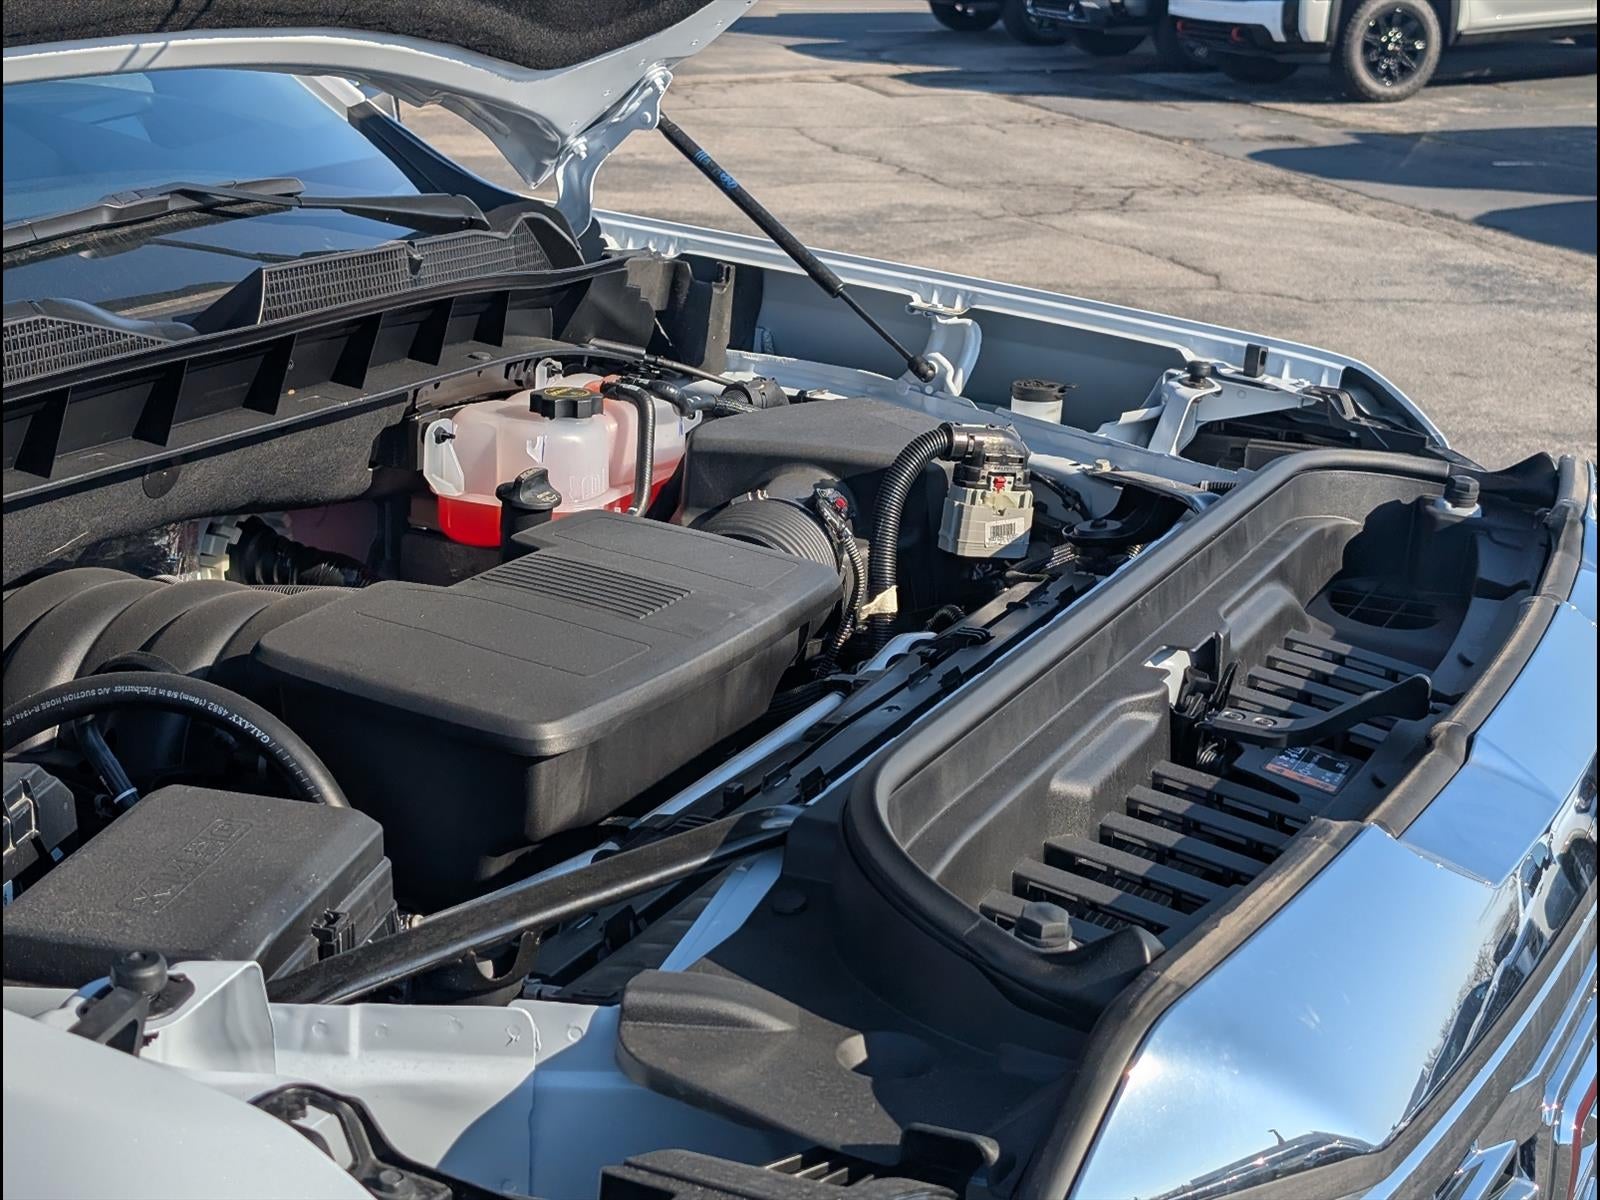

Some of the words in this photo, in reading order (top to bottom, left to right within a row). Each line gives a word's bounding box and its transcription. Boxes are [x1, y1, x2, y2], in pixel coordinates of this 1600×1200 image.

[63, 688, 96, 703] SUCTION
[97, 687, 111, 696] A/C
[41, 697, 62, 708] HOSE
[228, 713, 270, 744] GALAXY
